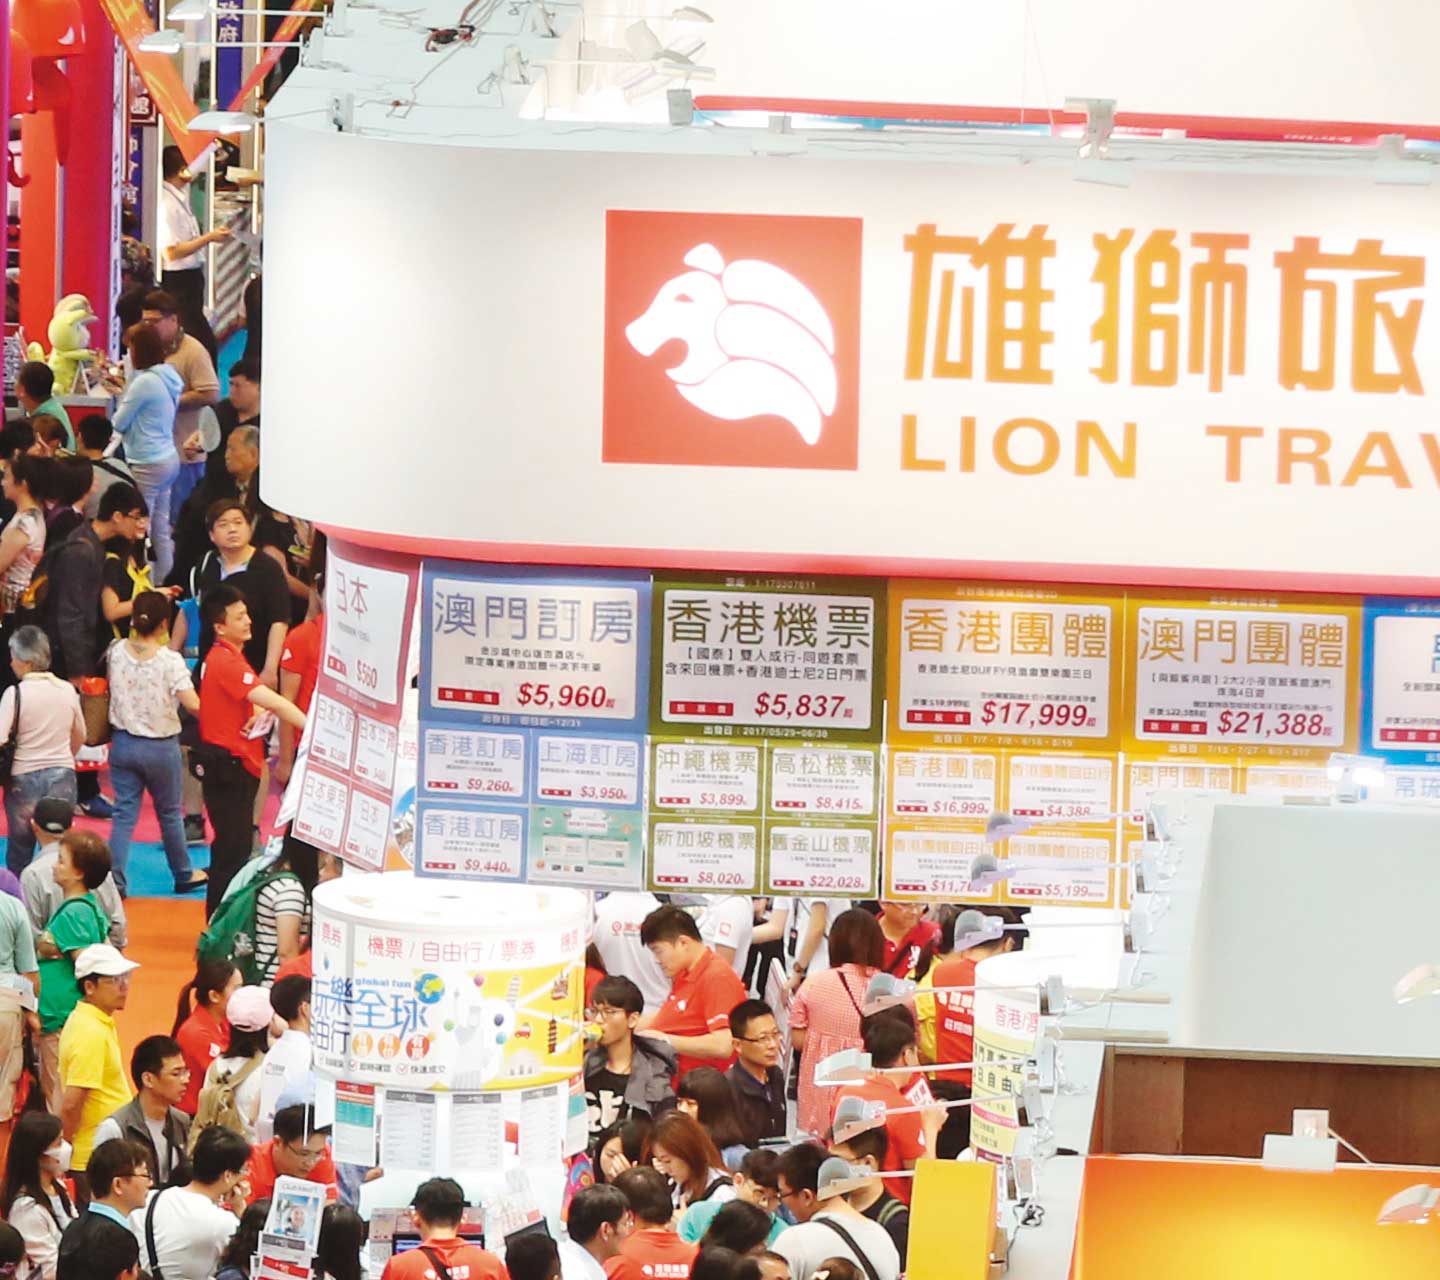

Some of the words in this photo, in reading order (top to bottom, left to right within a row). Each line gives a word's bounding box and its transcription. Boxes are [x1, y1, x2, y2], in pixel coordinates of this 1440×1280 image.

[901, 221, 1429, 397] 雄獅旅
[900, 413, 1140, 481] LION
[434, 590, 633, 644] 澳門訂房
[666, 598, 871, 648] 香港機票
[903, 607, 1108, 658] 香港團體
[1139, 617, 1345, 669] 澳門團體
[517, 682, 607, 709] $5,960
[754, 692, 846, 718] $5,837
[981, 700, 1087, 728] $17,999
[1217, 709, 1324, 737] $21,388
[426, 733, 522, 762] 香港訂房
[539, 737, 637, 769] 上海訂房
[658, 748, 758, 775] 沖繩機票
[775, 749, 873, 778] 高松機票
[424, 813, 520, 841] 香港訂房
